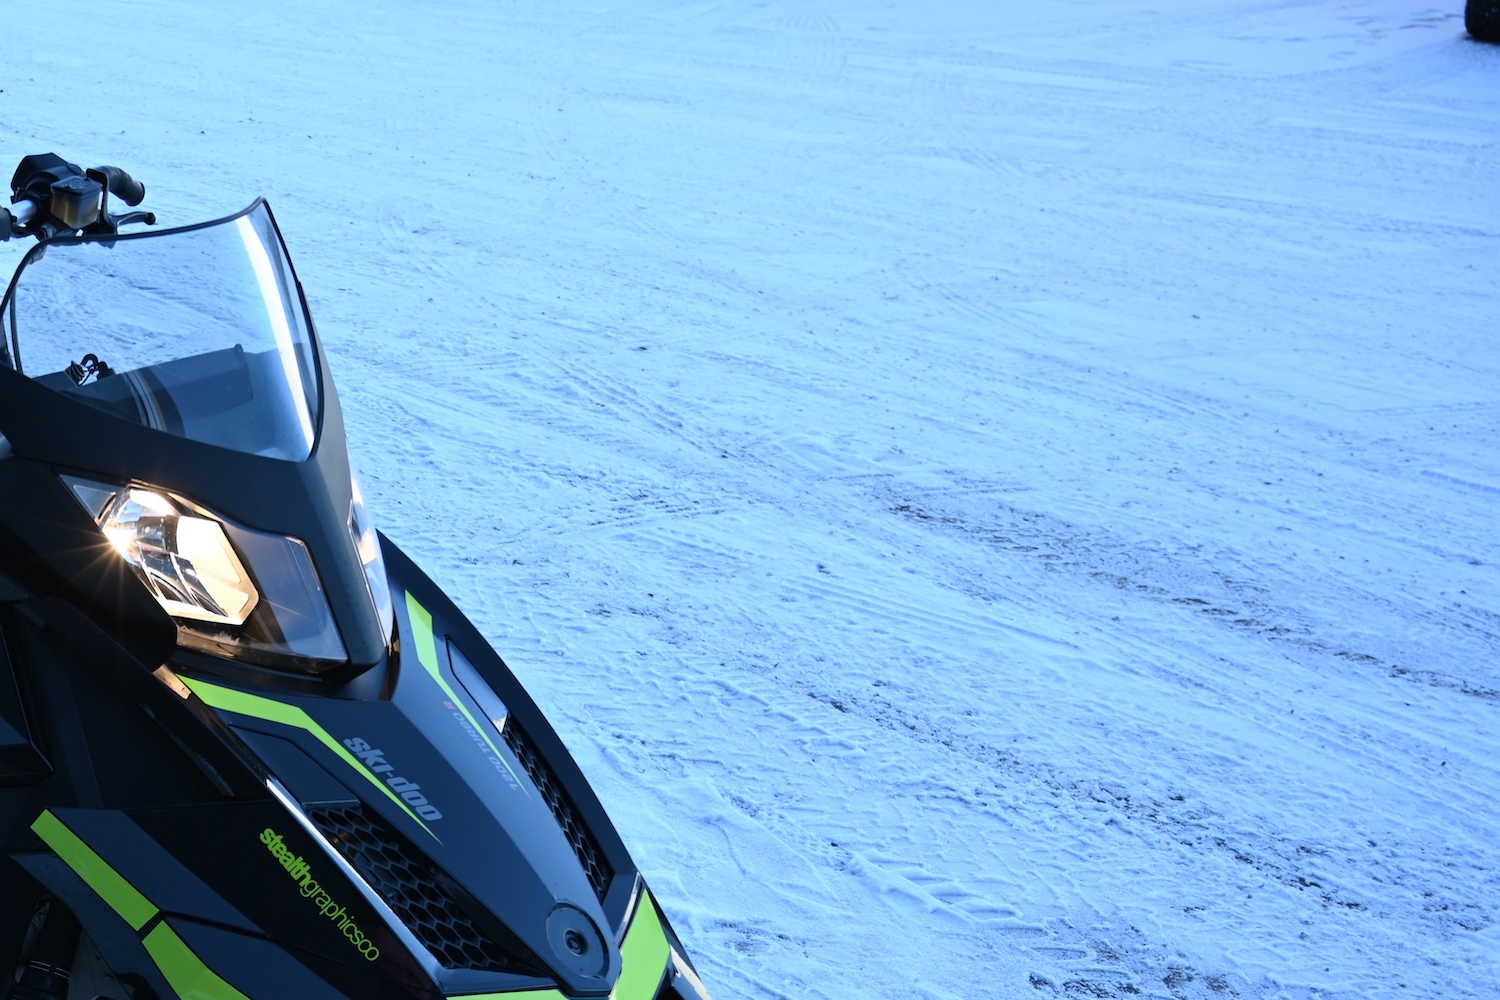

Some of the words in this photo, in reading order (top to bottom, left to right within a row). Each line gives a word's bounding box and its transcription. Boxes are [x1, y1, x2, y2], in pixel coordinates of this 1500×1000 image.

[453, 712, 491, 753] TURBO
[489, 756, 519, 790] 1200
[259, 827, 381, 961] stealthgraphicsco
